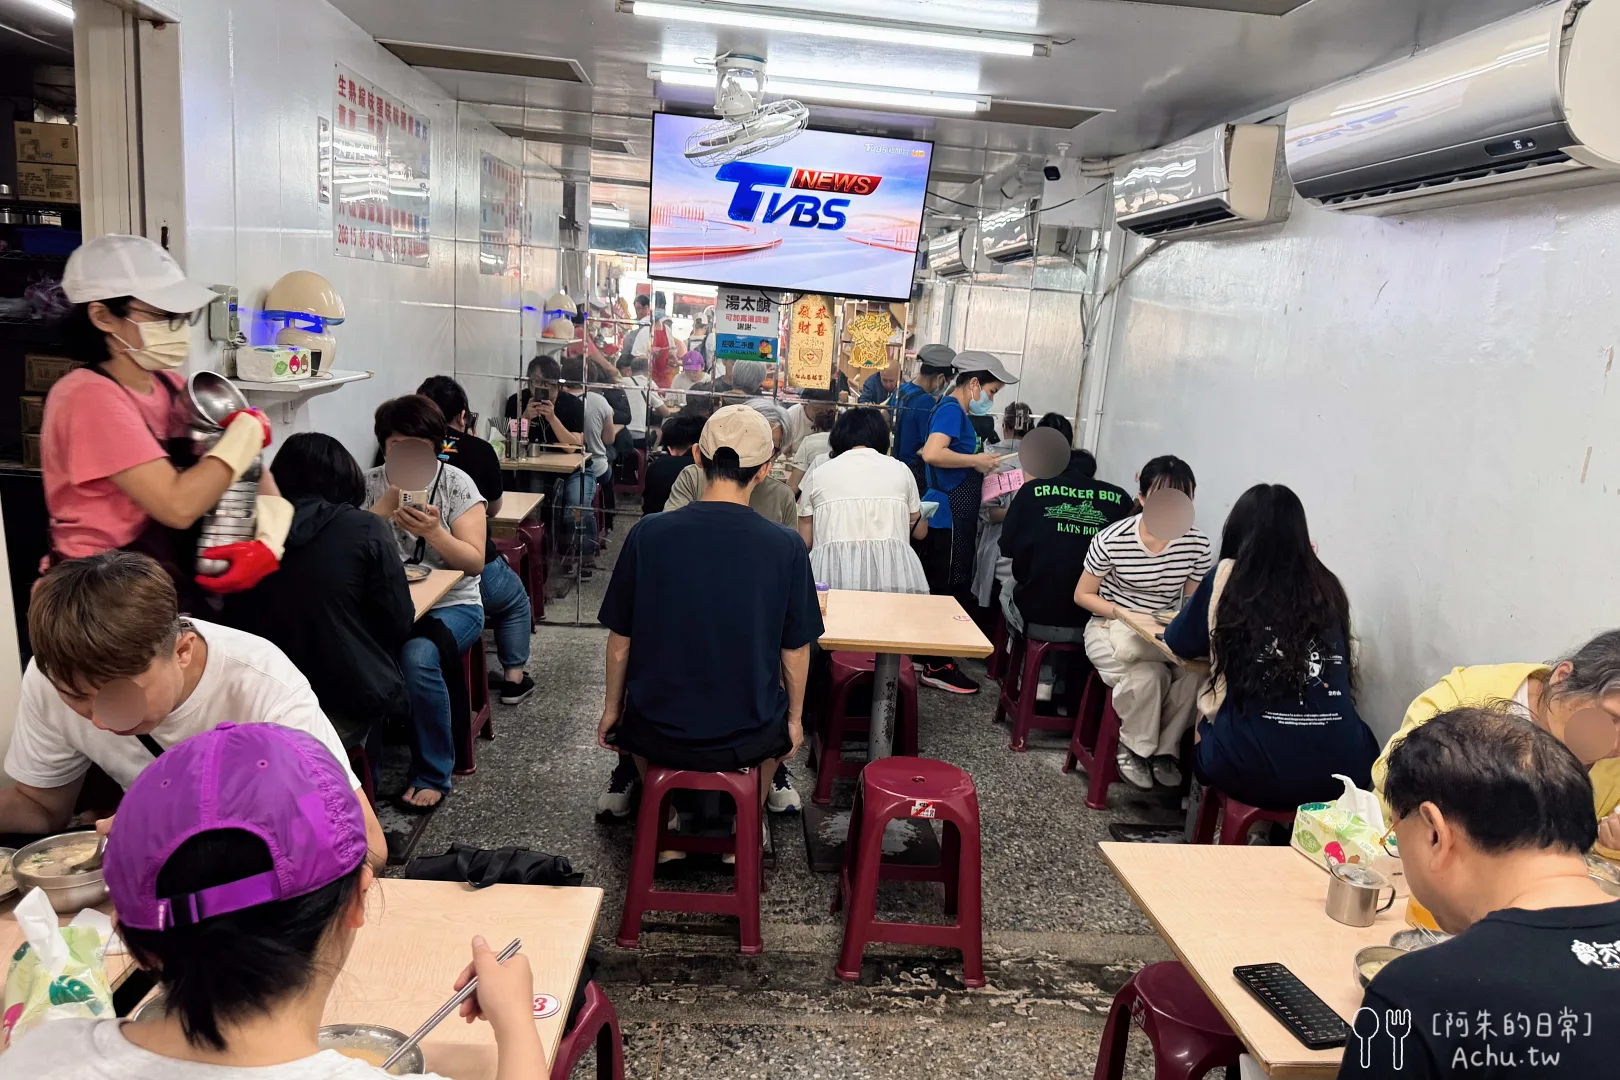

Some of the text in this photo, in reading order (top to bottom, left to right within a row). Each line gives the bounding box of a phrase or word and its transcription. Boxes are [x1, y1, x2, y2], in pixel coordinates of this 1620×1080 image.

[799, 170, 870, 194] NEWS
[715, 161, 851, 231] TVBS
[725, 294, 771, 312] 湯太鹹
[1034, 485, 1122, 505] CRACKER BOX
[1057, 521, 1081, 534] RATS
